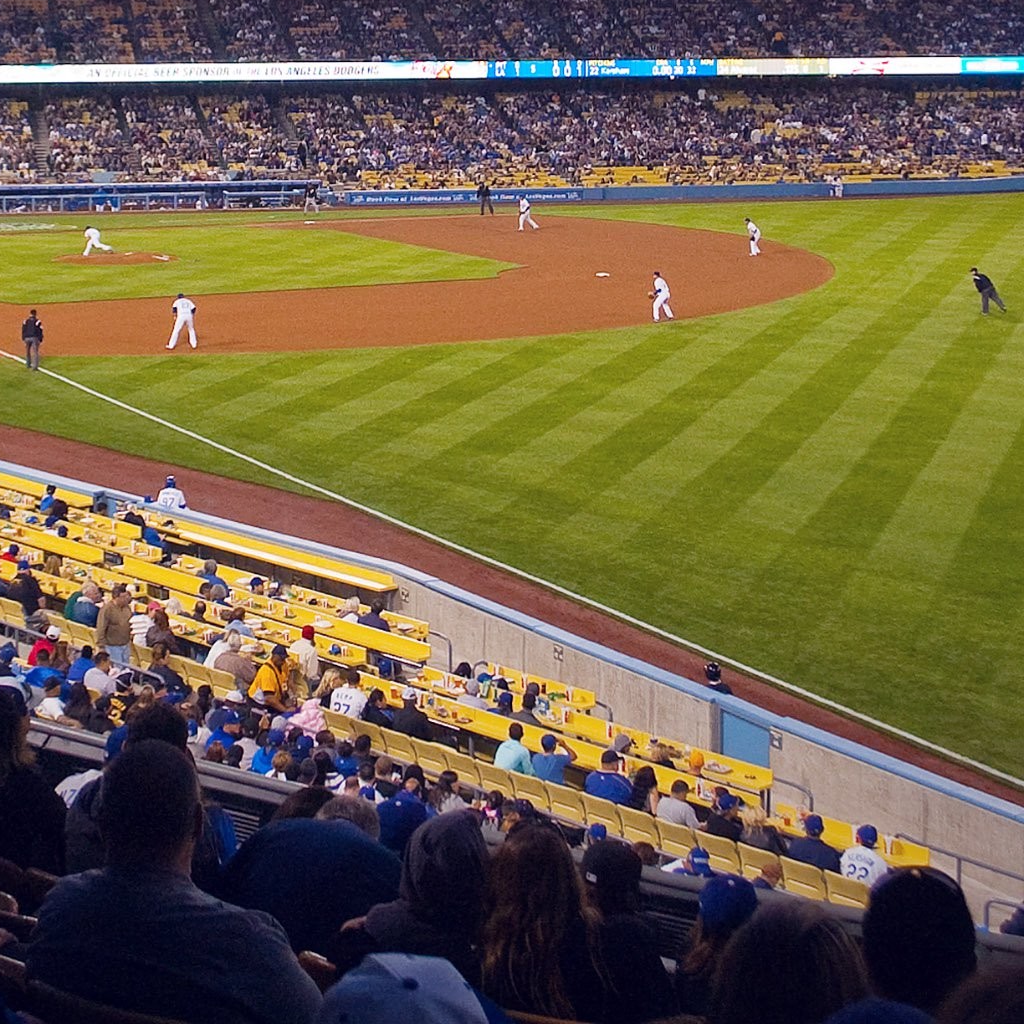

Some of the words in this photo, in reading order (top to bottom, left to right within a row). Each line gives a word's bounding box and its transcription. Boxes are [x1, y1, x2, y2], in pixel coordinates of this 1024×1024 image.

[182, 66, 230, 77] SPONSOR
[264, 66, 283, 76] LOS
[286, 66, 330, 76] ANGELES
[333, 65, 380, 75] DODGERS
[846, 863, 869, 881] 22
